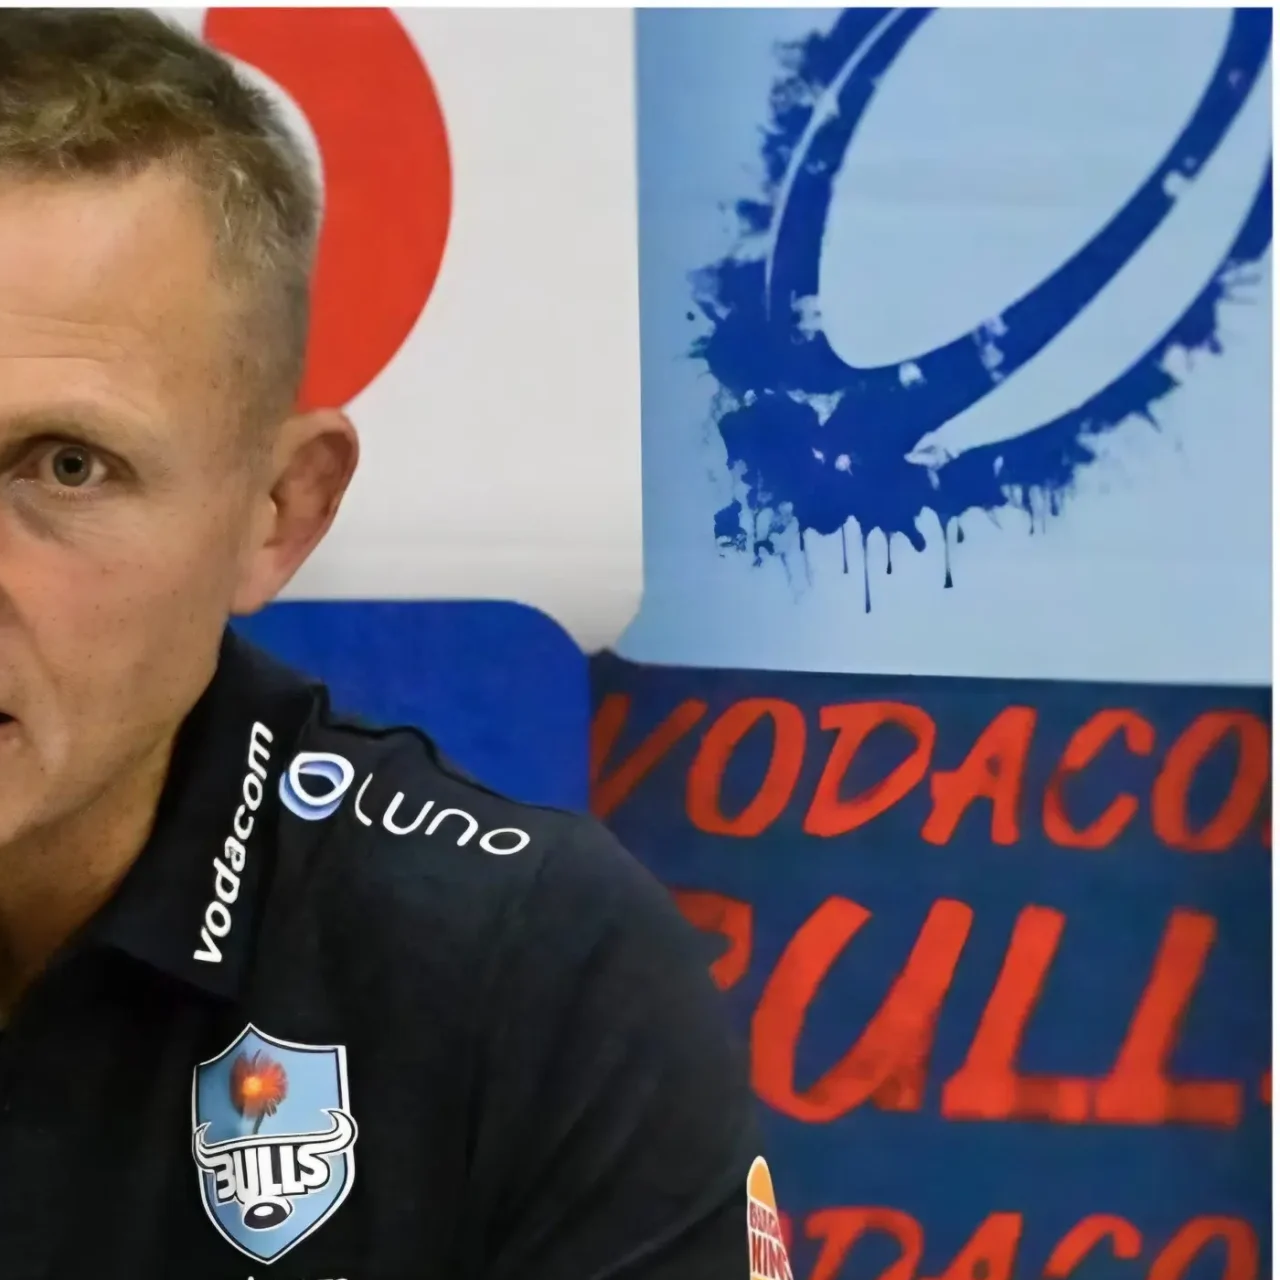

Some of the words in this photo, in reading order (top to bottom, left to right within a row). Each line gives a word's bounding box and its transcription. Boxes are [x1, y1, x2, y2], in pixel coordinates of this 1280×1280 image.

[193, 721, 273, 963] vodacom
[590, 693, 1272, 852] VODACO
[668, 886, 1272, 1130] ULL
[214, 1141, 331, 1201] BULLS
